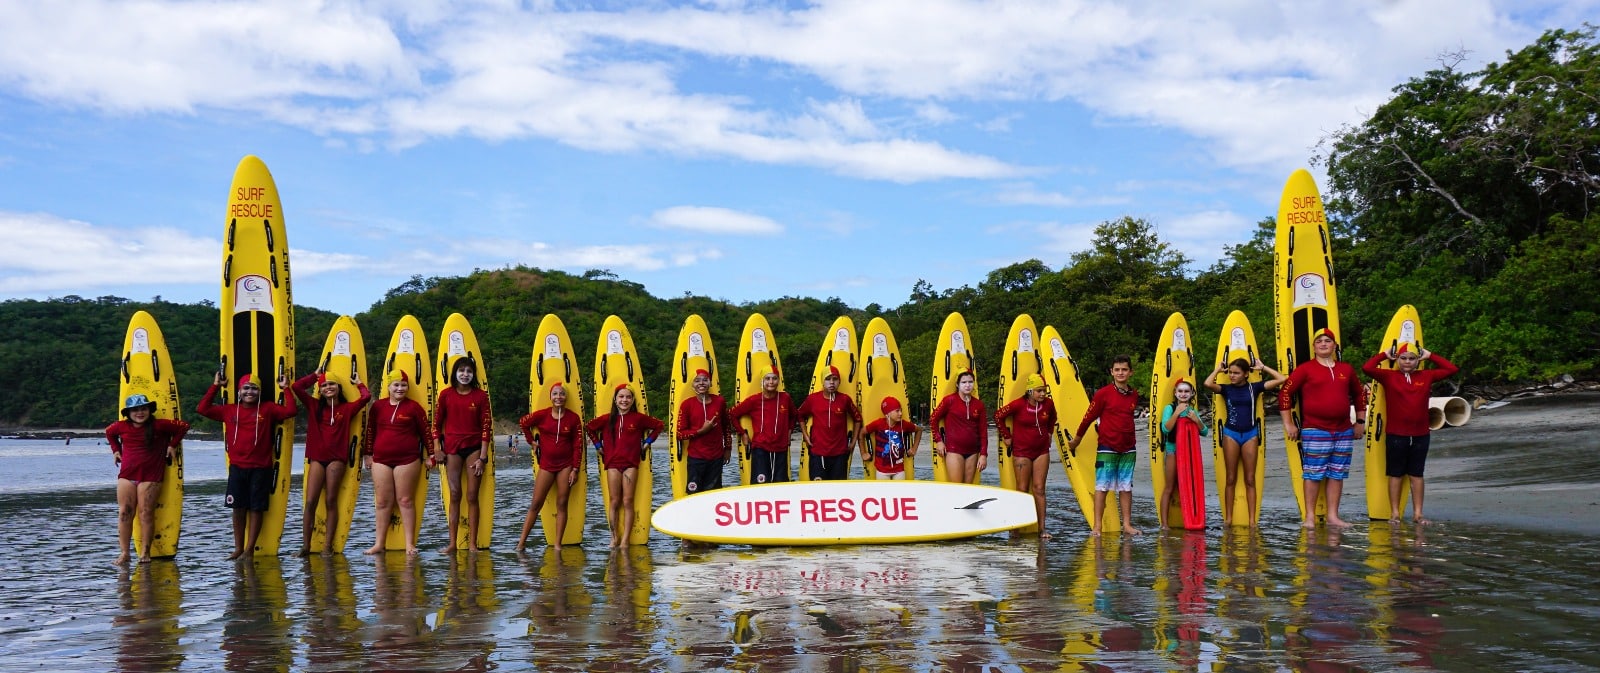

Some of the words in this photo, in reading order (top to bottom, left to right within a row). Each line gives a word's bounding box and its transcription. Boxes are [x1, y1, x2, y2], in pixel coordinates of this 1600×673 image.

[237, 187, 265, 201] SURF
[1292, 196, 1317, 210] SURF
[231, 204, 273, 218] RESCUE
[1287, 211, 1324, 225] RESCUE
[714, 500, 791, 527] SURF
